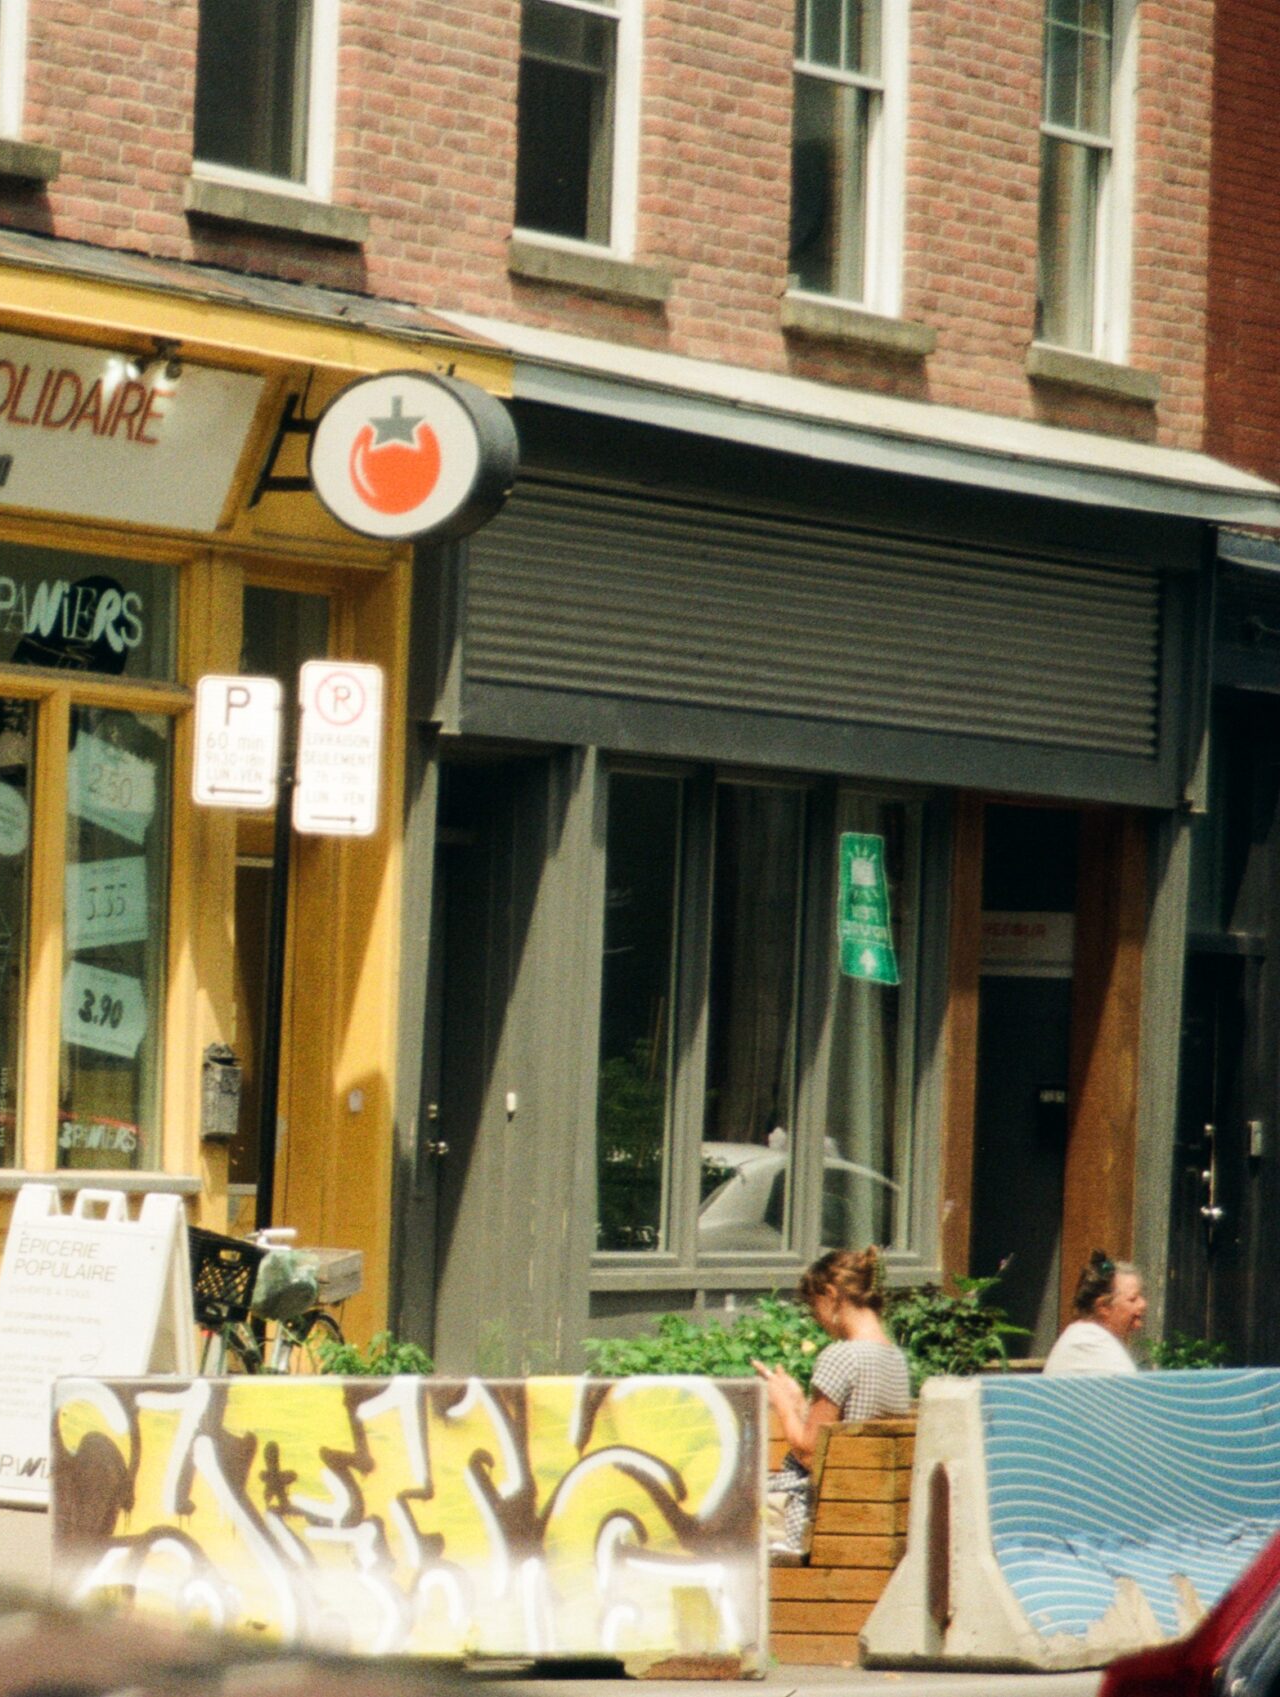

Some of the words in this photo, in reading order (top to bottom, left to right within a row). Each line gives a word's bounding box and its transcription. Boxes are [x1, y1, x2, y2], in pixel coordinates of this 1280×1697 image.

[224, 685, 251, 727] P
[78, 988, 124, 1029] 3.90
[17, 1236, 101, 1260] ÉPICERIE
[13, 1257, 118, 1283] POPULAIRE
